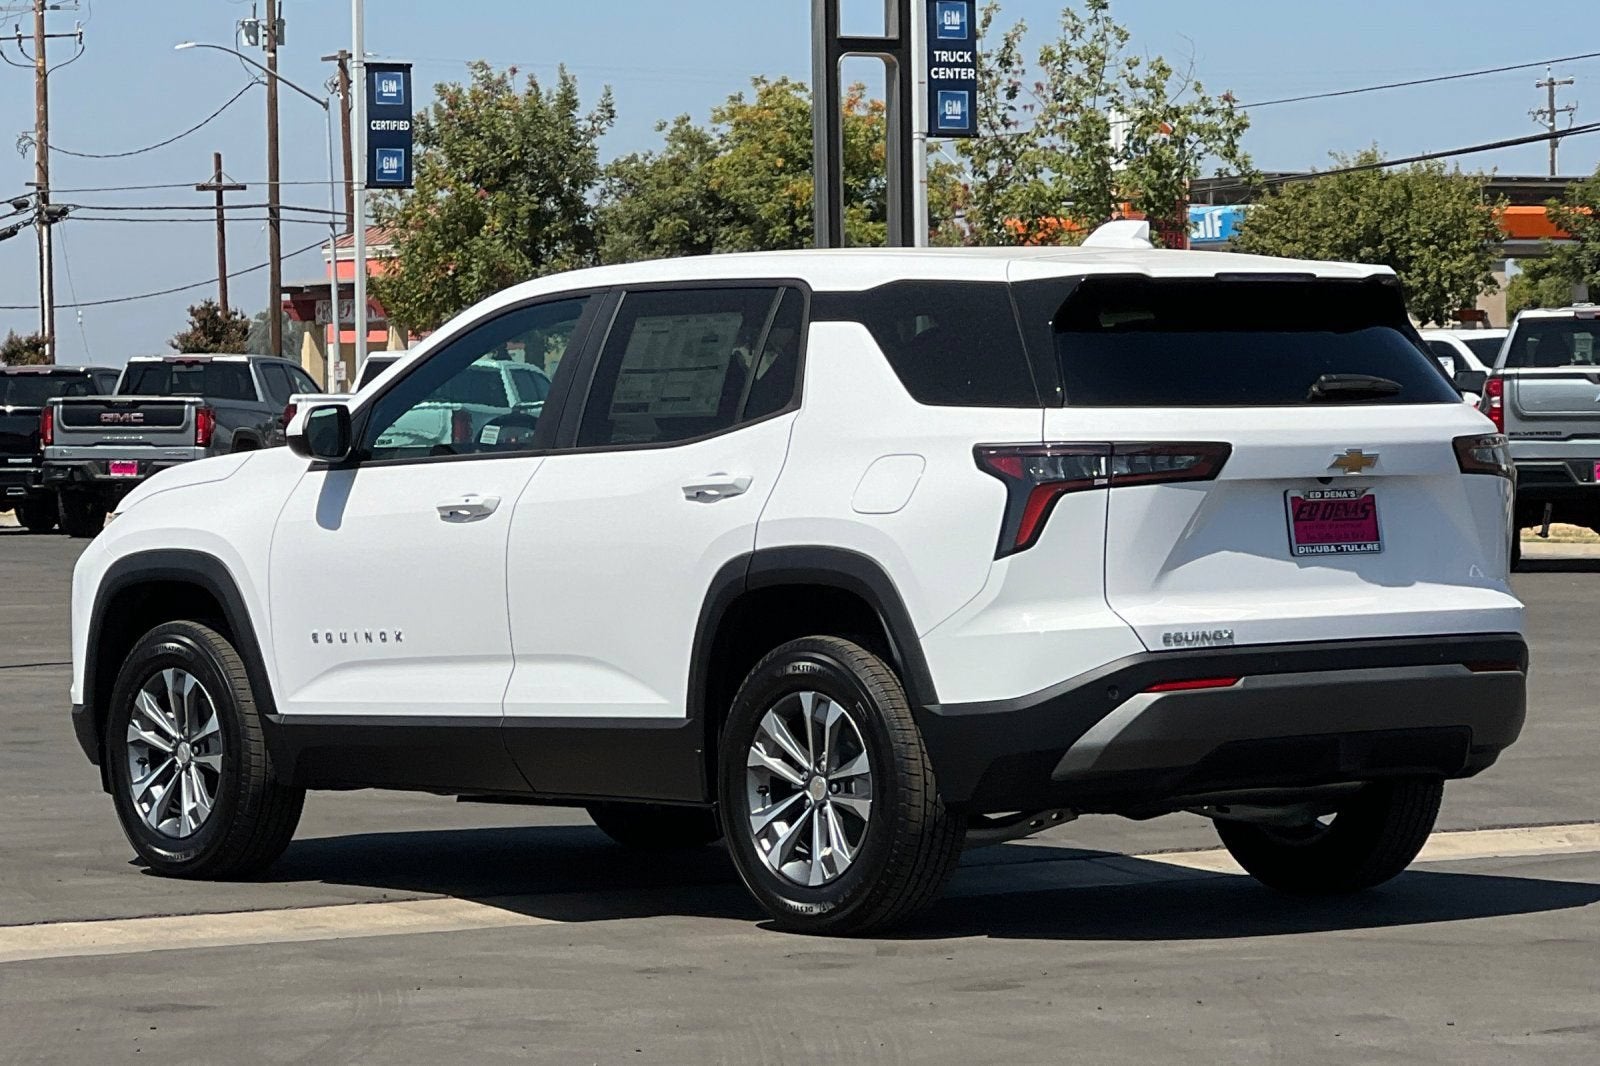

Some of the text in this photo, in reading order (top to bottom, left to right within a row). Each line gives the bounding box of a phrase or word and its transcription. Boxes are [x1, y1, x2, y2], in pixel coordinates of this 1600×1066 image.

[944, 10, 960, 25] GM
[934, 51, 971, 62] TRUCK
[931, 67, 975, 79] CENTER
[382, 79, 397, 93] GM
[945, 100, 961, 115] GM
[370, 120, 410, 131] CERTIFIED
[383, 157, 398, 170] GM
[100, 412, 144, 423] GMC
[1309, 491, 1322, 499] ED
[1341, 543, 1380, 553] TULARE
[311, 631, 402, 643] EQUINOX
[1163, 629, 1234, 646] EQUINOX
